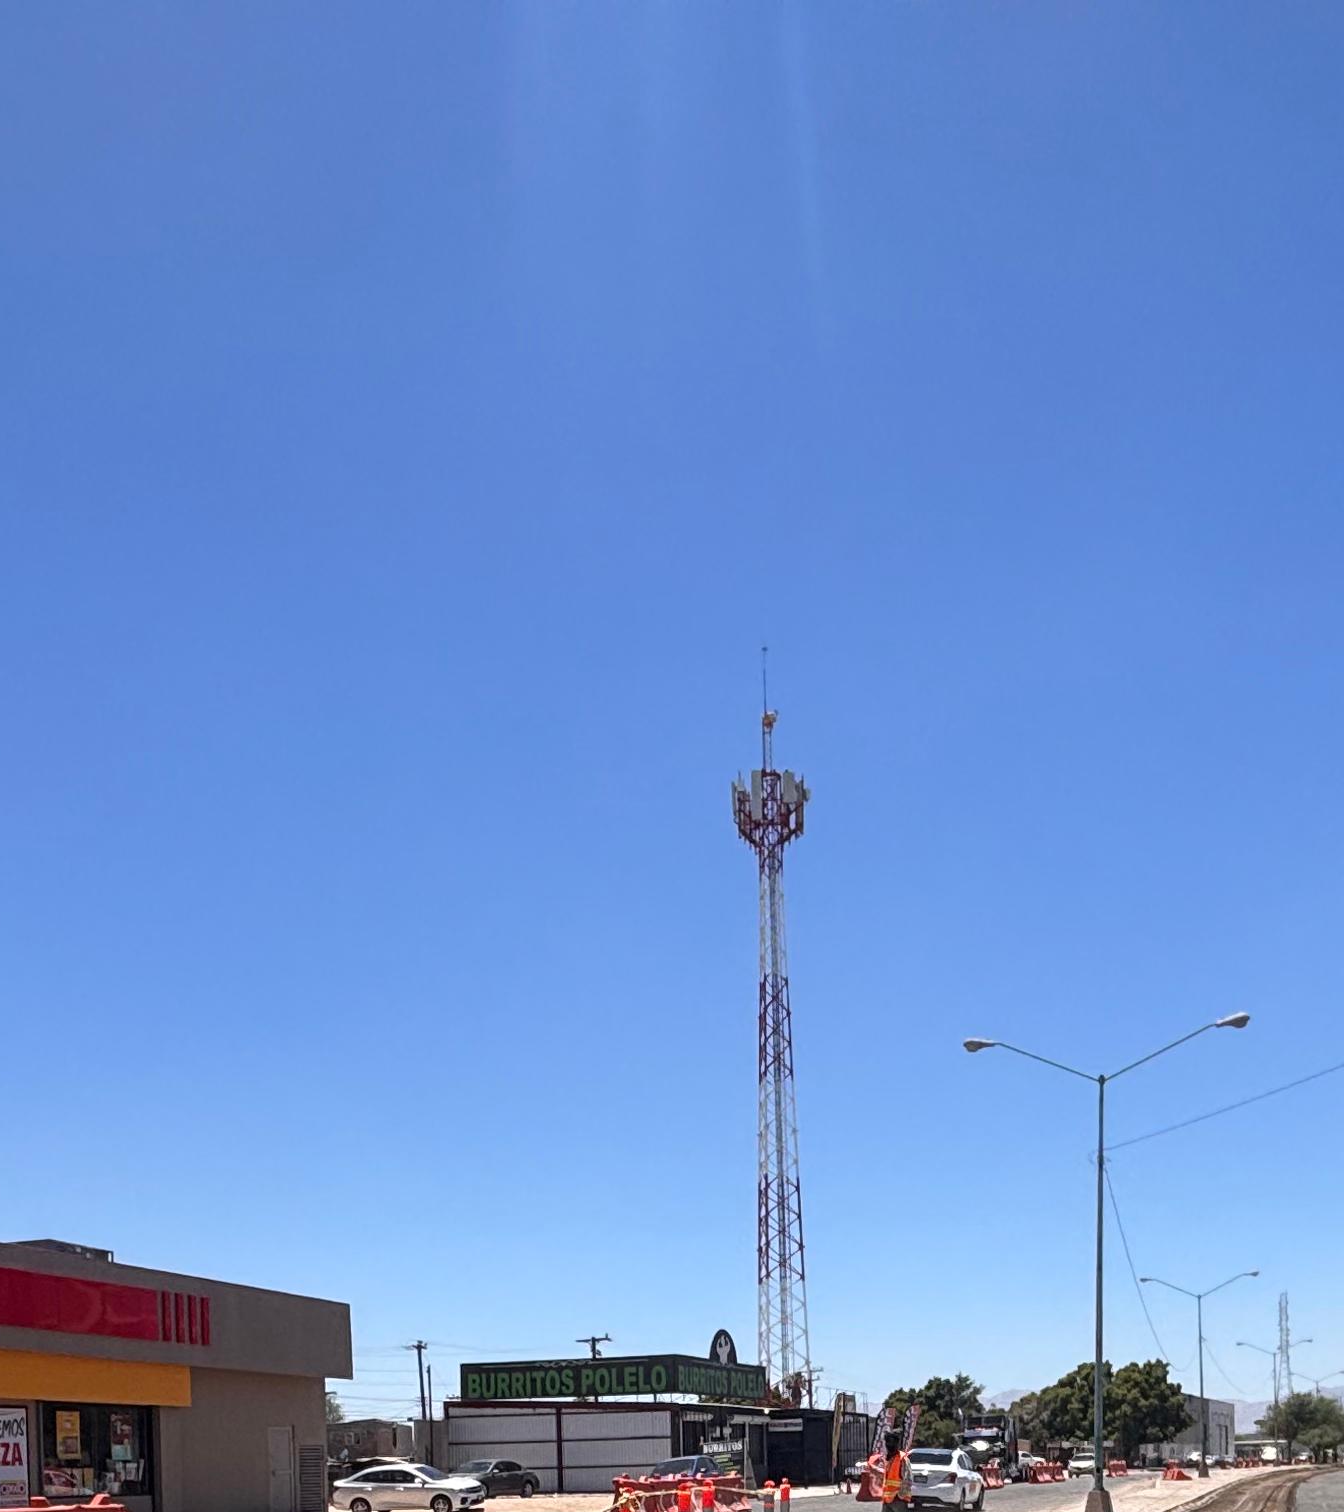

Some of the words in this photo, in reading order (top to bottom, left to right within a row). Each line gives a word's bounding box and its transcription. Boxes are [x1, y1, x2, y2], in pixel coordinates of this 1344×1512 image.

[467, 1369, 574, 1398] BURRITOS
[581, 1365, 667, 1394] POLELO
[678, 1365, 728, 1395] BURRITOS
